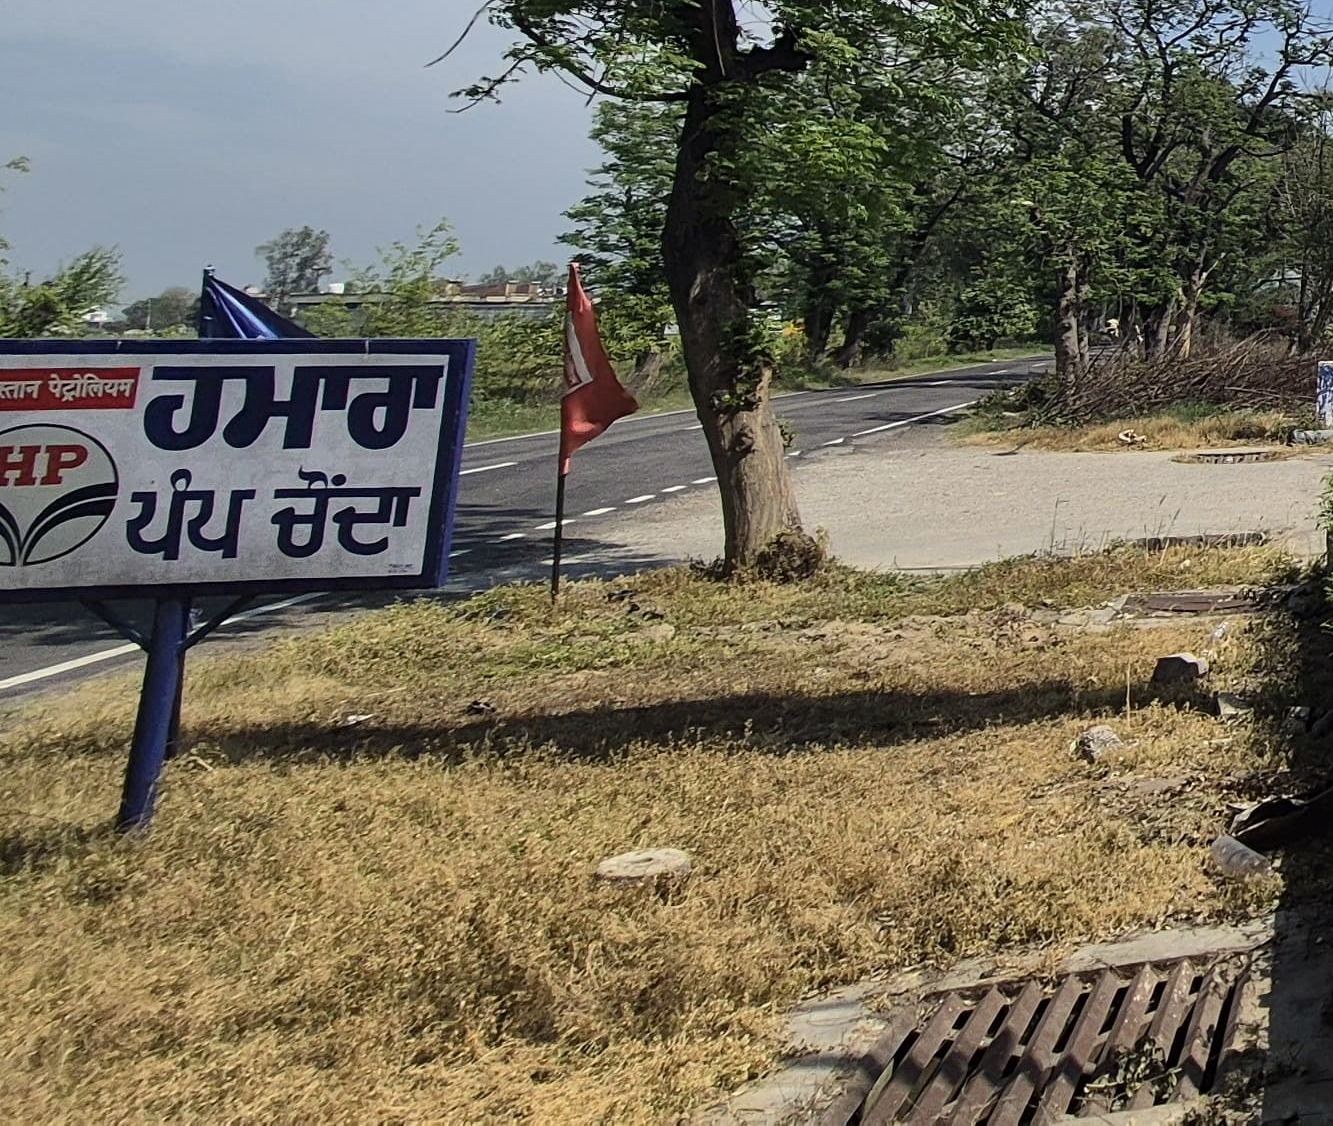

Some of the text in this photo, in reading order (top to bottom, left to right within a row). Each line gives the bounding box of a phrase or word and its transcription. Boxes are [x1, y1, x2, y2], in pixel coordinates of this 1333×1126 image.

[48, 373, 135, 402] पेट्रोलियम
[144, 366, 444, 451] ਹਮਾਰਾ
[0, 445, 88, 487] HP
[126, 469, 256, 560] ਪੰਪ
